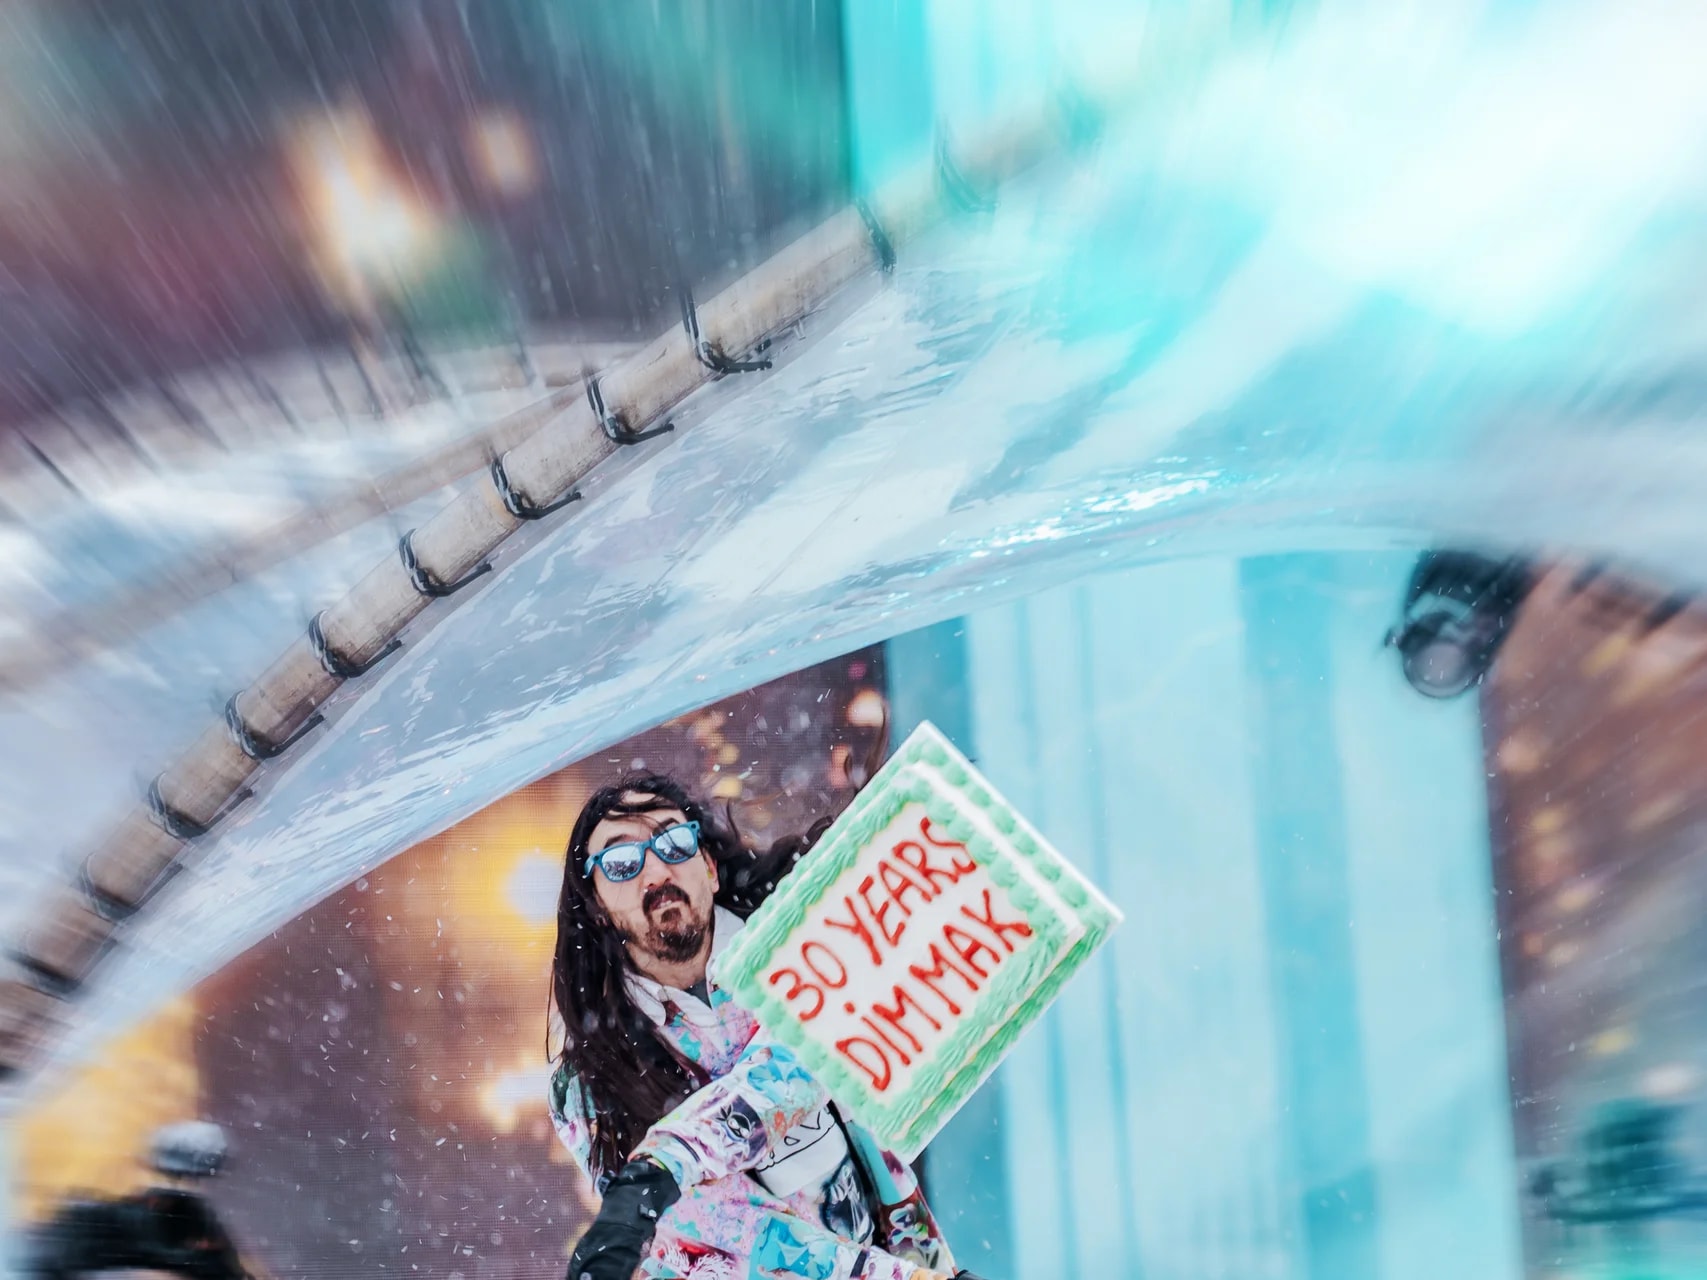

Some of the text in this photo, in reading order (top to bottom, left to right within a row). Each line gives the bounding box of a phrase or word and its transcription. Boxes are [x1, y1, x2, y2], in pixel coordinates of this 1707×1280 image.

[769, 816, 978, 1022] 30 YEARS
[908, 888, 1033, 1017] MAK
